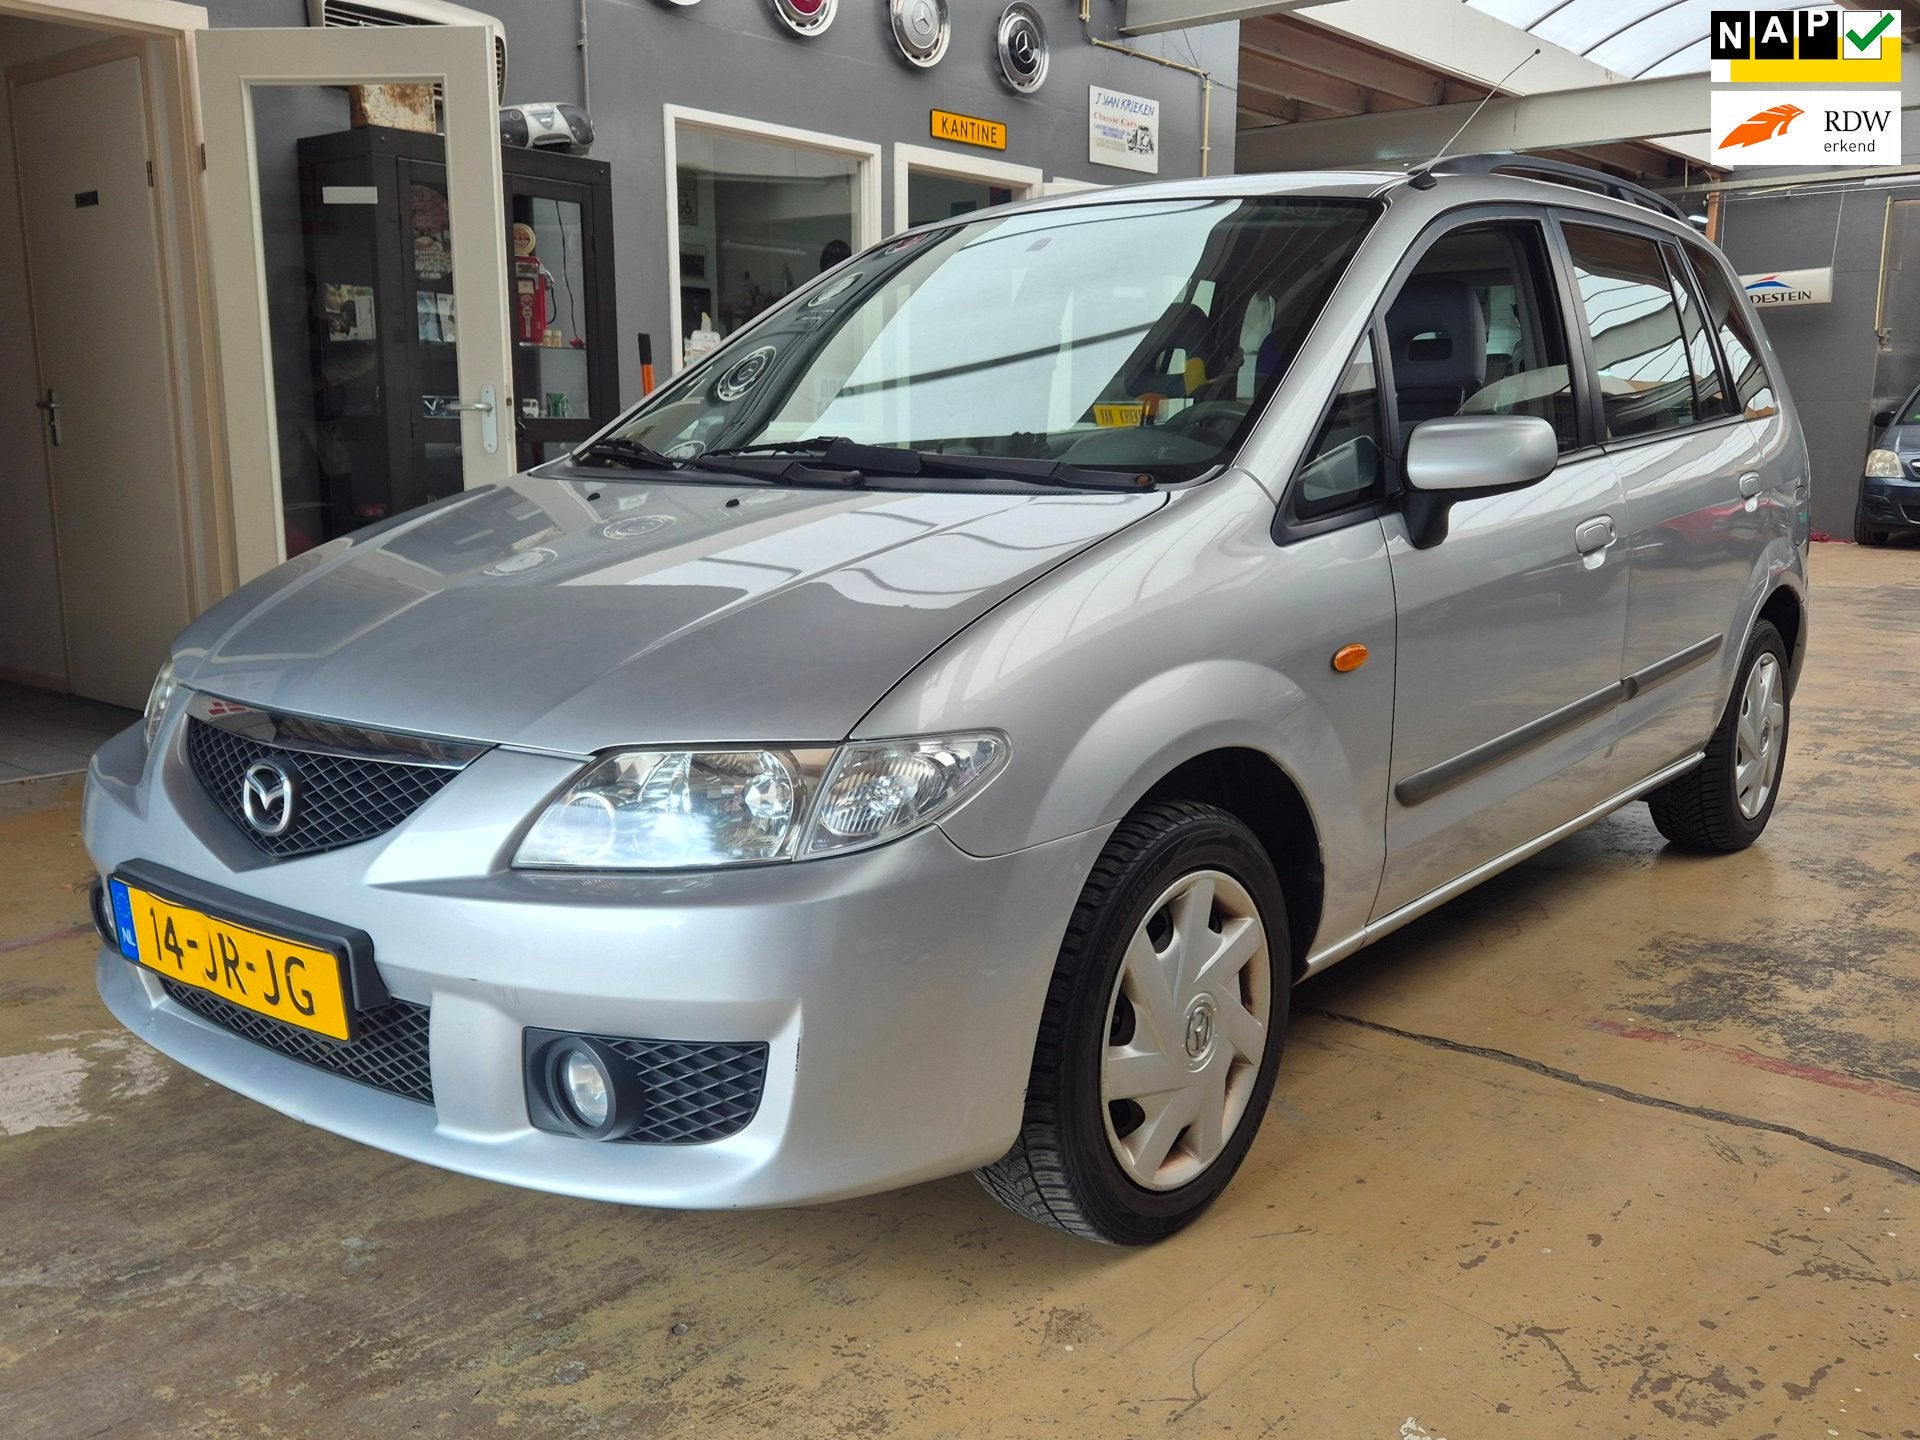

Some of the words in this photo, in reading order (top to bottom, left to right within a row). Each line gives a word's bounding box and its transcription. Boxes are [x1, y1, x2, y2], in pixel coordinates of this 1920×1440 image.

[1120, 98, 1155, 116] KRIEKEN
[1093, 111, 1118, 124] Classic
[1121, 118, 1138, 128] Cars
[941, 116, 997, 144] KANTINE
[1100, 408, 1114, 425] VAN
[121, 926, 136, 948] NL
[150, 906, 316, 1016] 14-JR-JG
